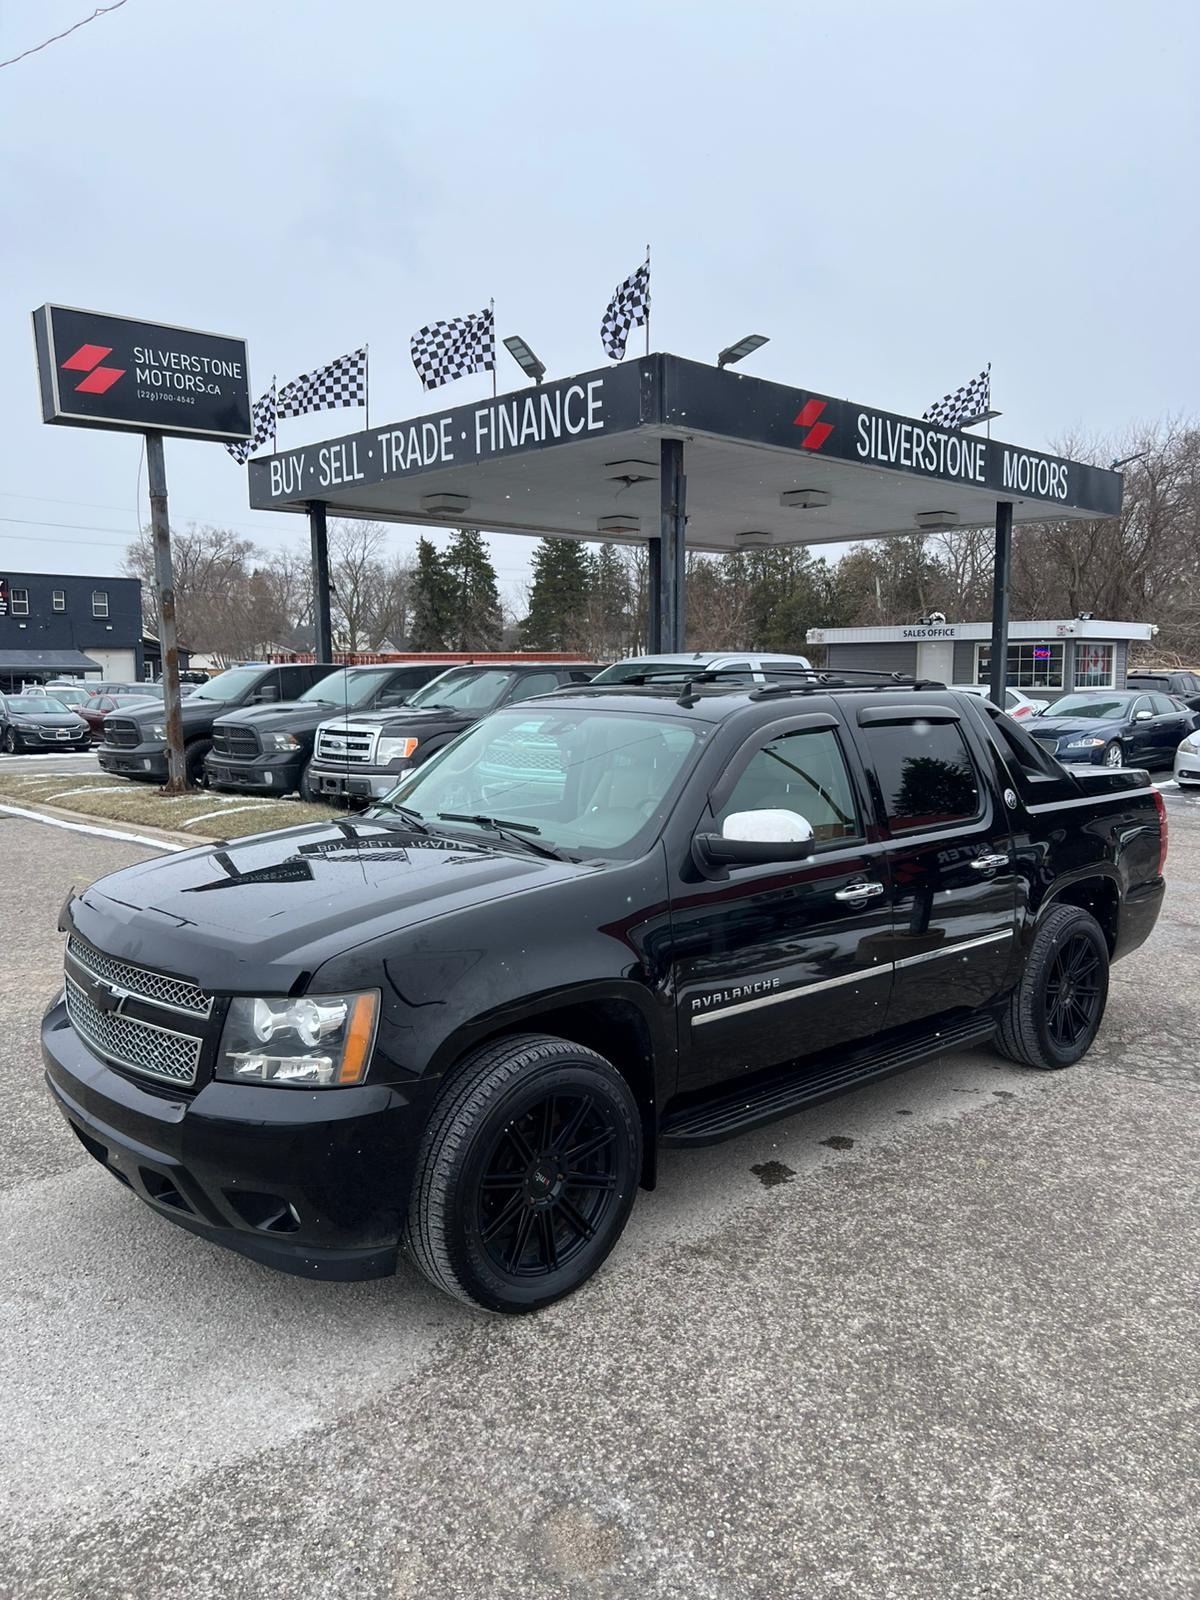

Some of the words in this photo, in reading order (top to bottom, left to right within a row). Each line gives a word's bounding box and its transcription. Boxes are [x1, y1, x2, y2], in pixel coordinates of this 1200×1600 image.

[133, 347, 242, 379] SILVERSTONE
[270, 453, 305, 497] BUY
[319, 440, 365, 487] SELL
[377, 417, 454, 474] TRADE
[475, 379, 604, 454] FINANCE
[856, 413, 986, 482] SILVERSTONE
[1002, 450, 1068, 500] MOTORS
[903, 629, 926, 638] SALES
[927, 628, 955, 637] OFFICE
[691, 977, 780, 1010] AVALANCHE
